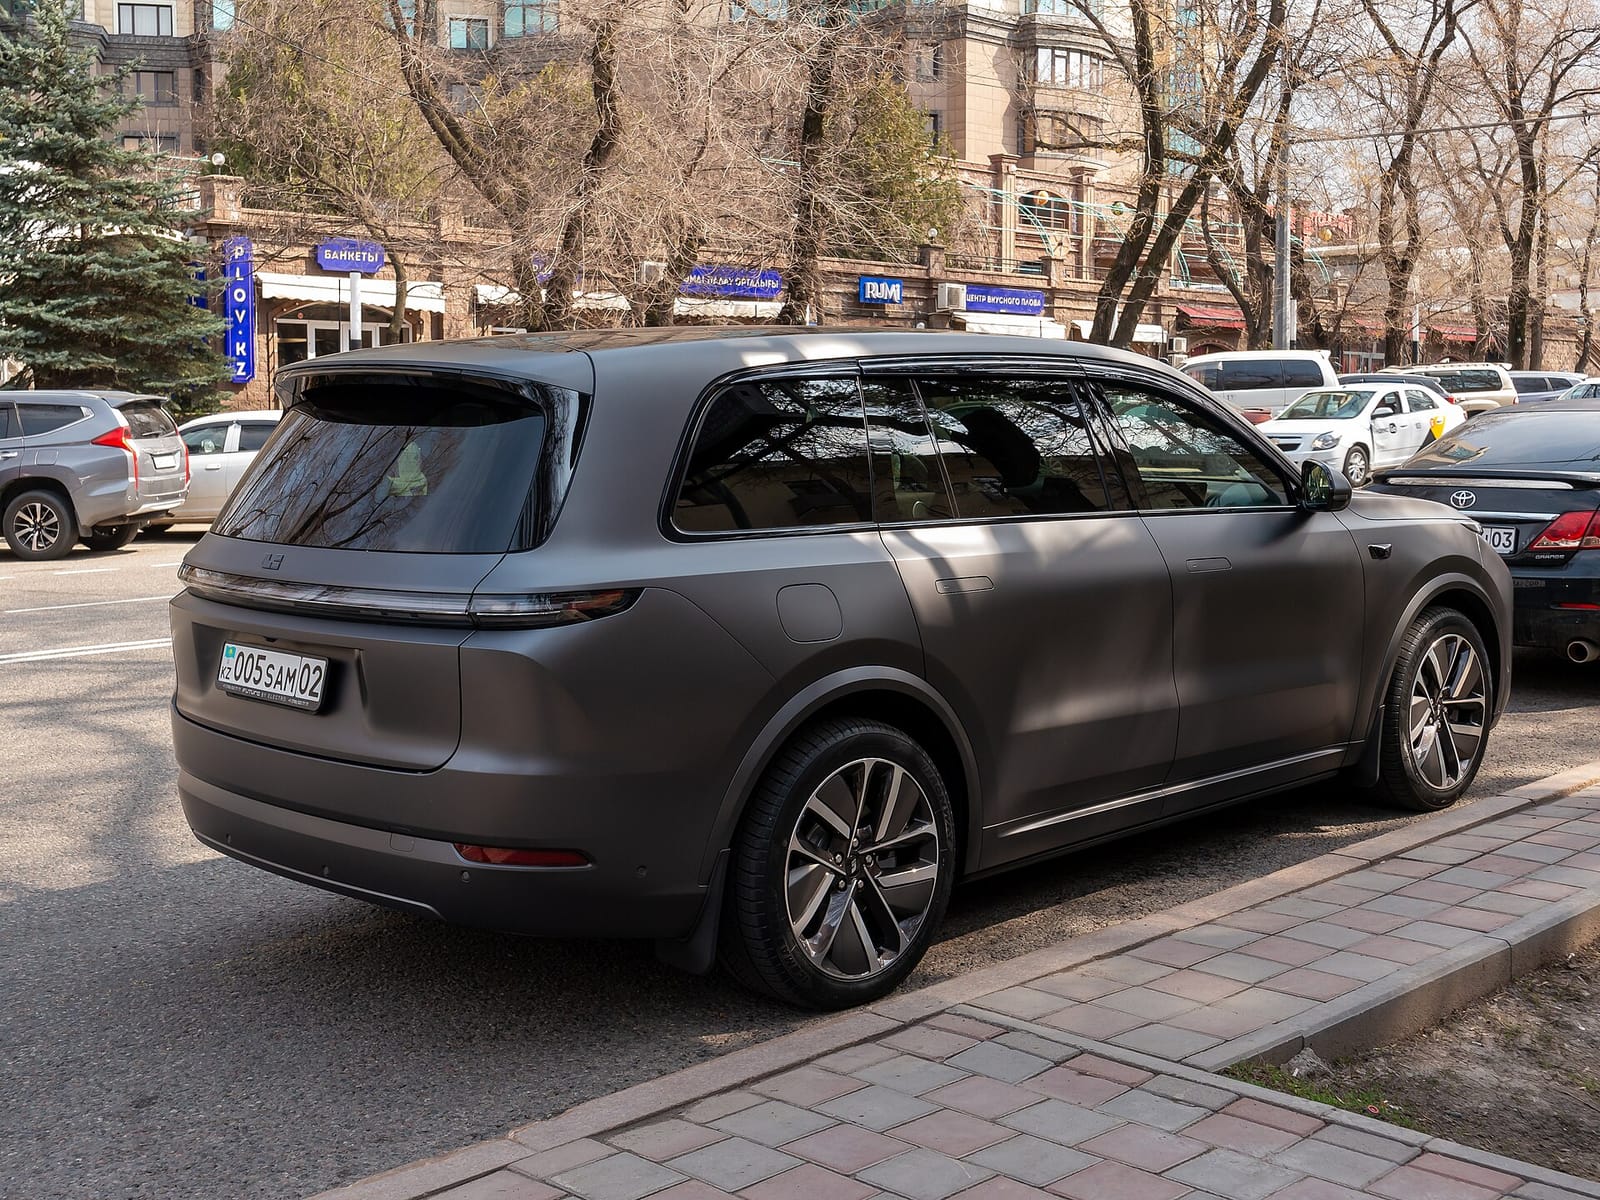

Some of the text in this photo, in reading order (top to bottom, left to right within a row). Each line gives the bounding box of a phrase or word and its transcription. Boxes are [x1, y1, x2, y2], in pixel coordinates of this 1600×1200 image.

[324, 249, 378, 262] БАНКЕТЫ
[966, 293, 1041, 307] ЦЕНТР ВКУСНОГО ПЛОВА
[1491, 531, 1513, 549] 03
[221, 665, 232, 680] KZ
[234, 651, 323, 698] 005 SAM 02
